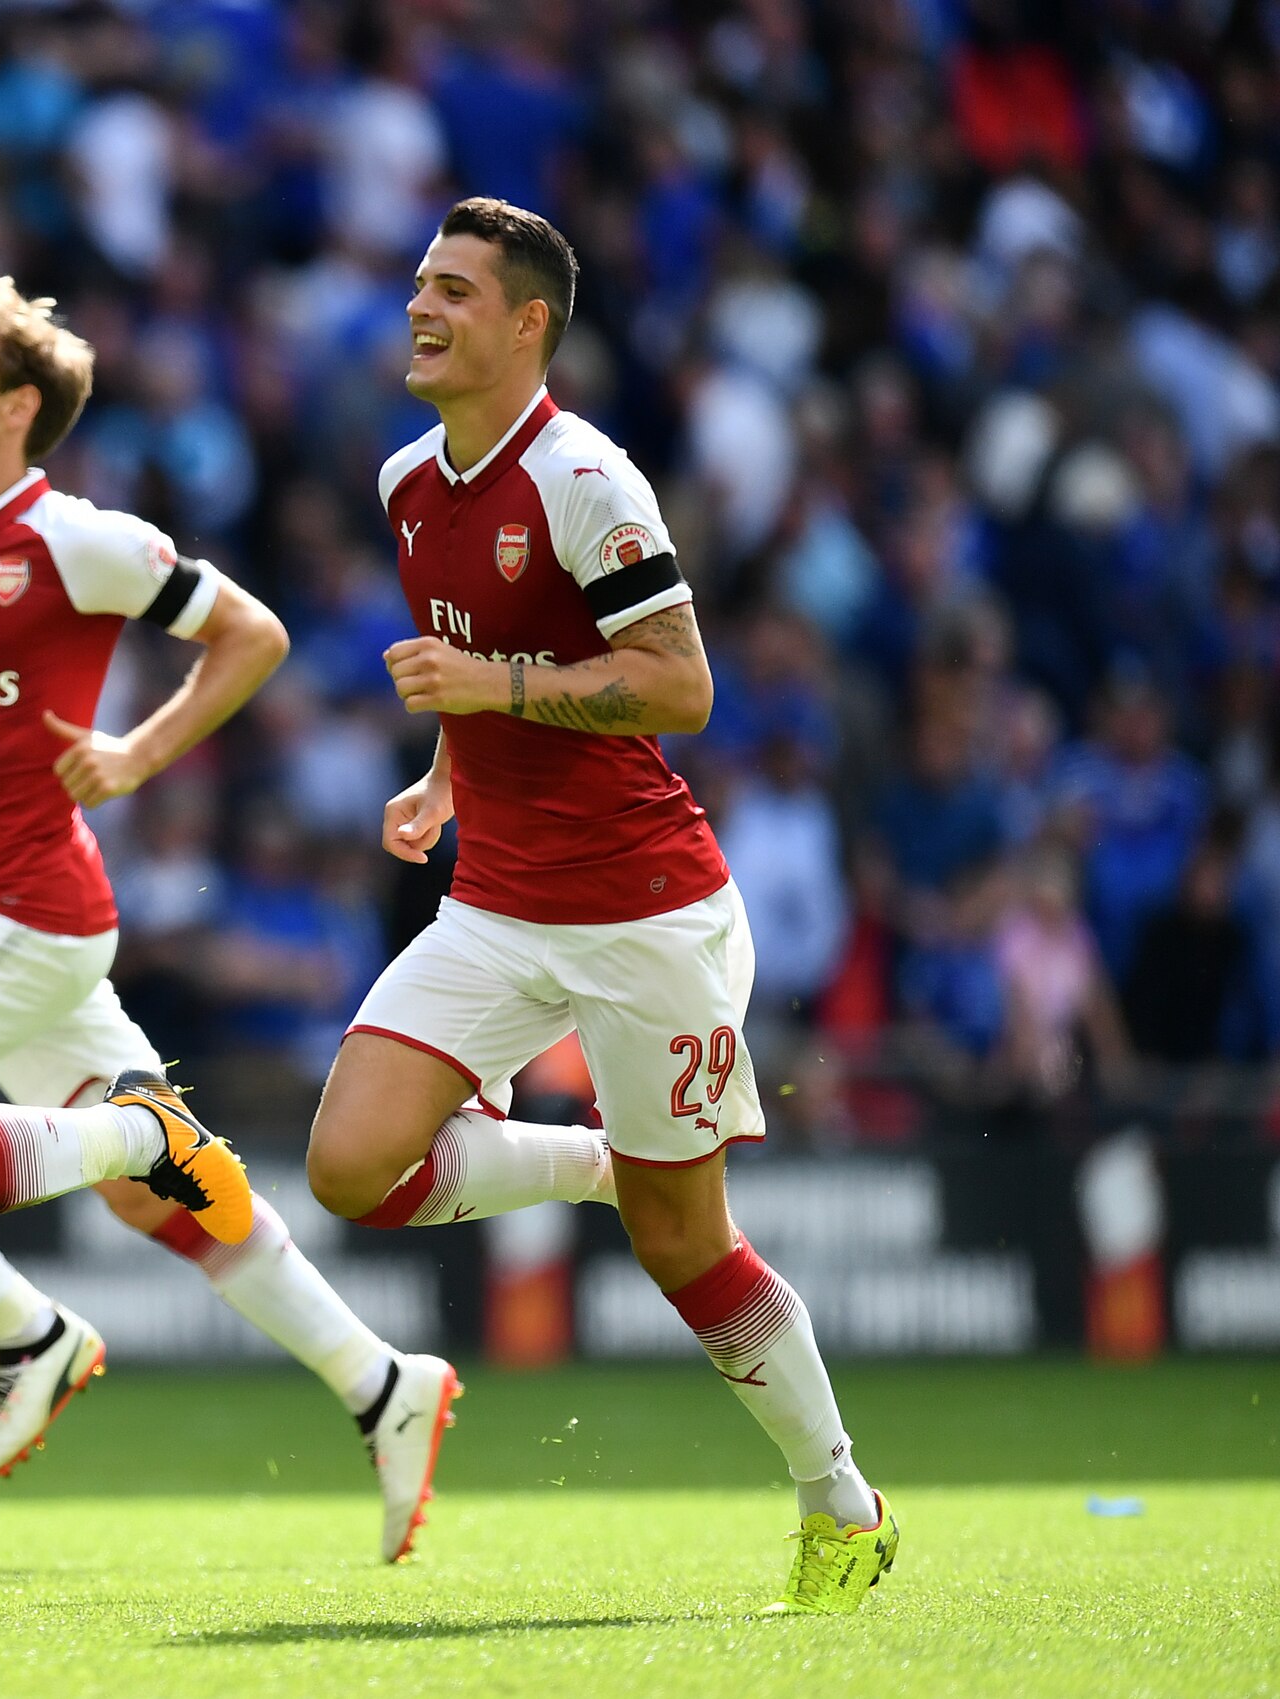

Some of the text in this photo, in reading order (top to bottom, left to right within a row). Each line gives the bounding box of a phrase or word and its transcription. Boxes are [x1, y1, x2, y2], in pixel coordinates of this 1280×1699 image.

[604, 527, 649, 561] THE ARSENAL
[430, 598, 472, 643] Fly
[669, 1025, 736, 1117] 29
